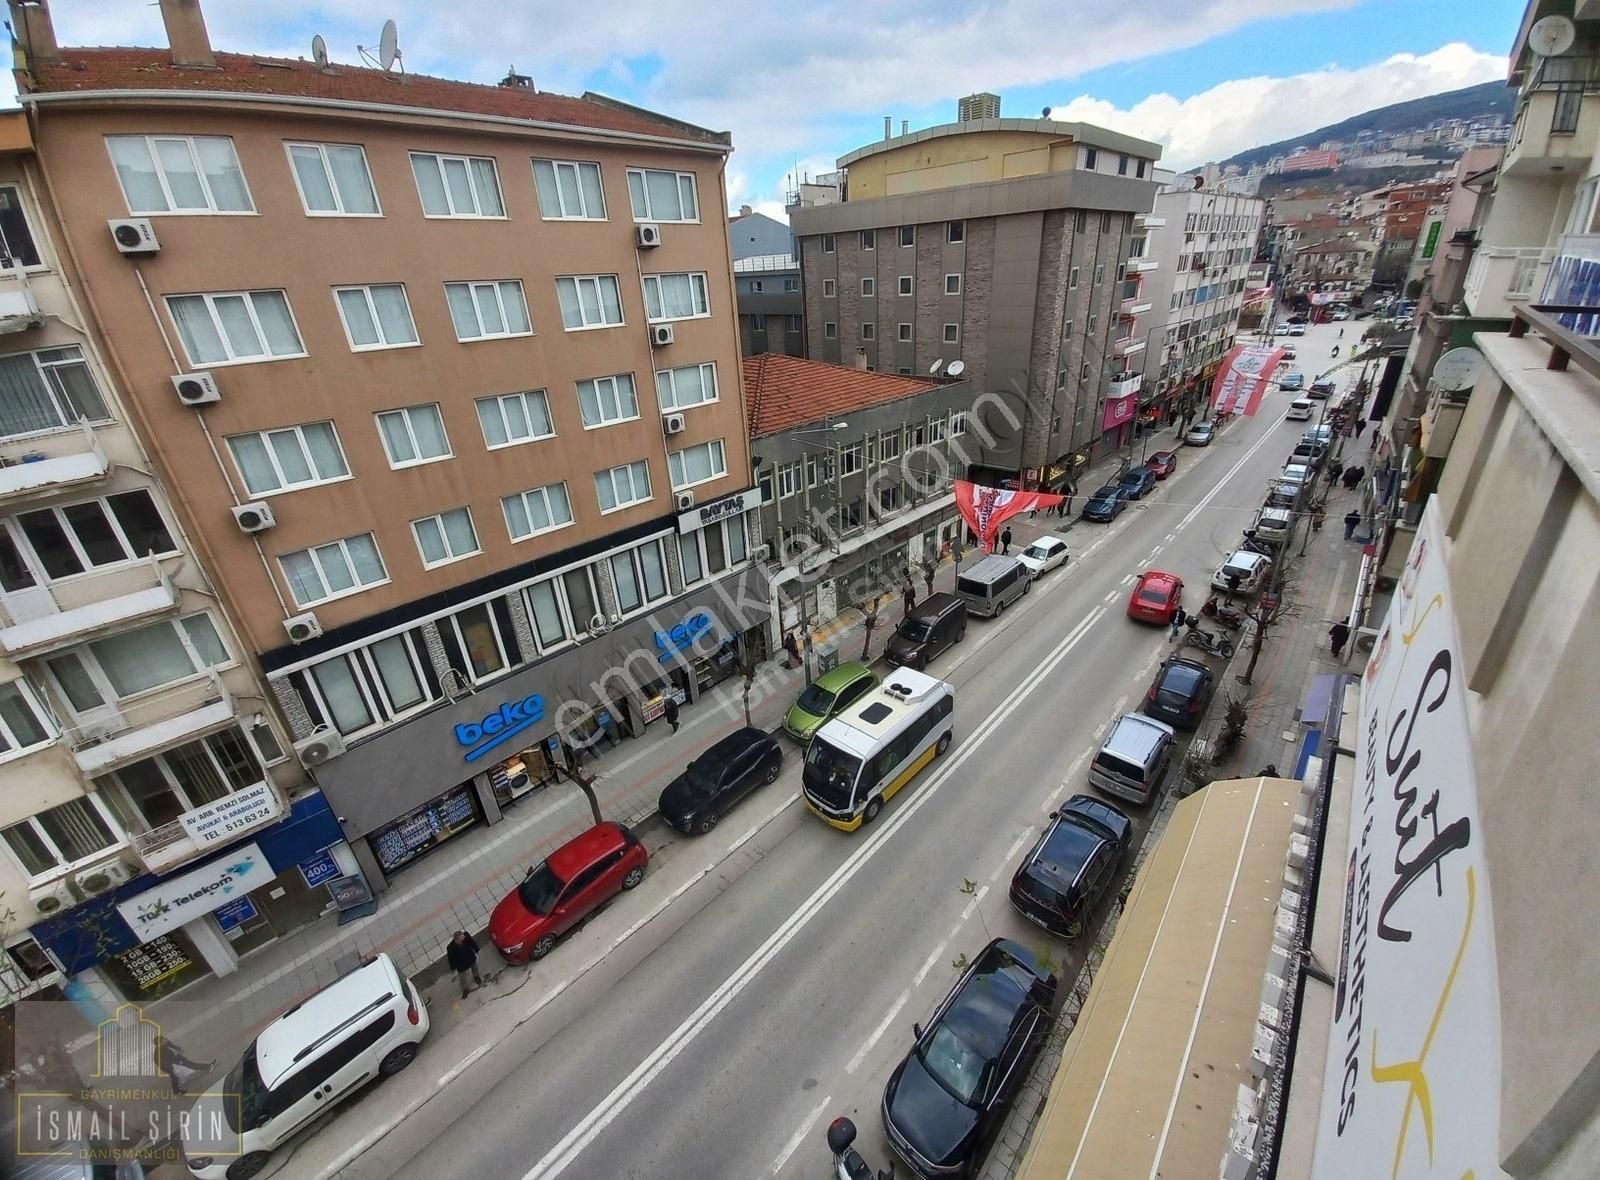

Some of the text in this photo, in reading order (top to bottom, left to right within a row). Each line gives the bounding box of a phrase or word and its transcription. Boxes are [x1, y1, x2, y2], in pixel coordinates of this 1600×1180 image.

[654, 612, 711, 650] beko
[454, 693, 545, 747] beko
[196, 817, 223, 833] AVUKAT
[203, 829, 221, 841] TEL
[225, 819, 245, 832] 513
[244, 813, 257, 824] 63
[258, 807, 270, 818] 24
[307, 863, 328, 878] 400
[172, 876, 233, 907] Telekom
[121, 956, 129, 964] 2
[128, 948, 143, 960] GB
[131, 968, 144, 978] 15
[143, 961, 158, 972] GB
[1337, 852, 1372, 1137] AESTHETICS
